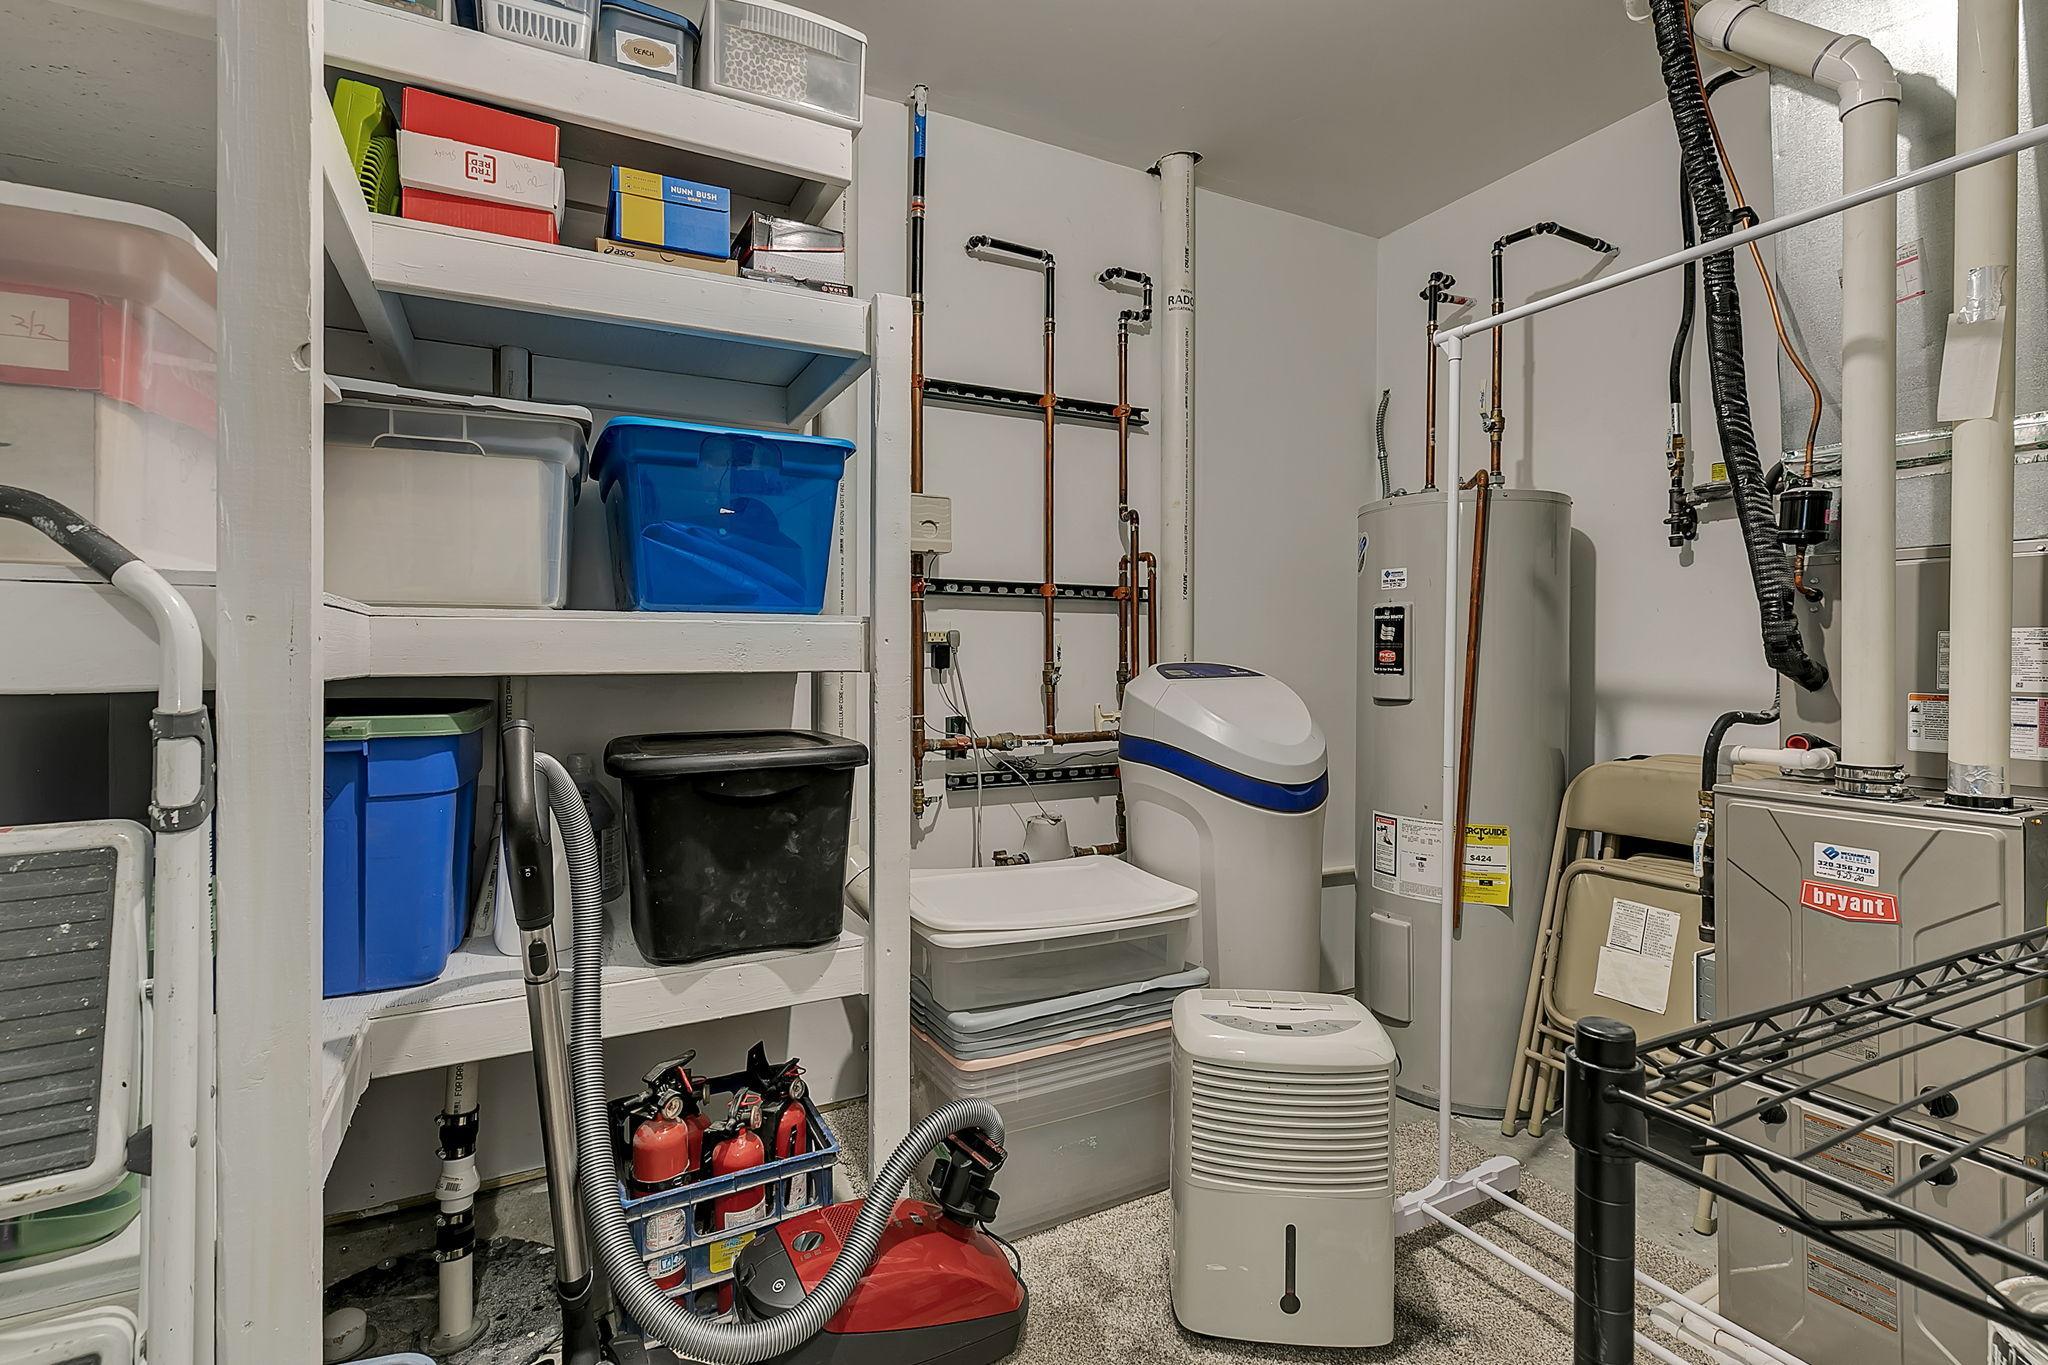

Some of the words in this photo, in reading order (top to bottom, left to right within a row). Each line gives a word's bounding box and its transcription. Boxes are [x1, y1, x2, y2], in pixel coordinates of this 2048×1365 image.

[633, 47, 655, 59] BEACH
[471, 158, 491, 169] RED
[471, 166, 491, 177] TRU
[670, 185, 694, 197] NUNN
[696, 190, 718, 201] BUSH
[505, 694, 513, 723] CELLULA
[1469, 854, 1492, 862] $424
[1812, 886, 1885, 917] bryant
[455, 1062, 465, 1081] DRA
[454, 1081, 463, 1097] FOR
